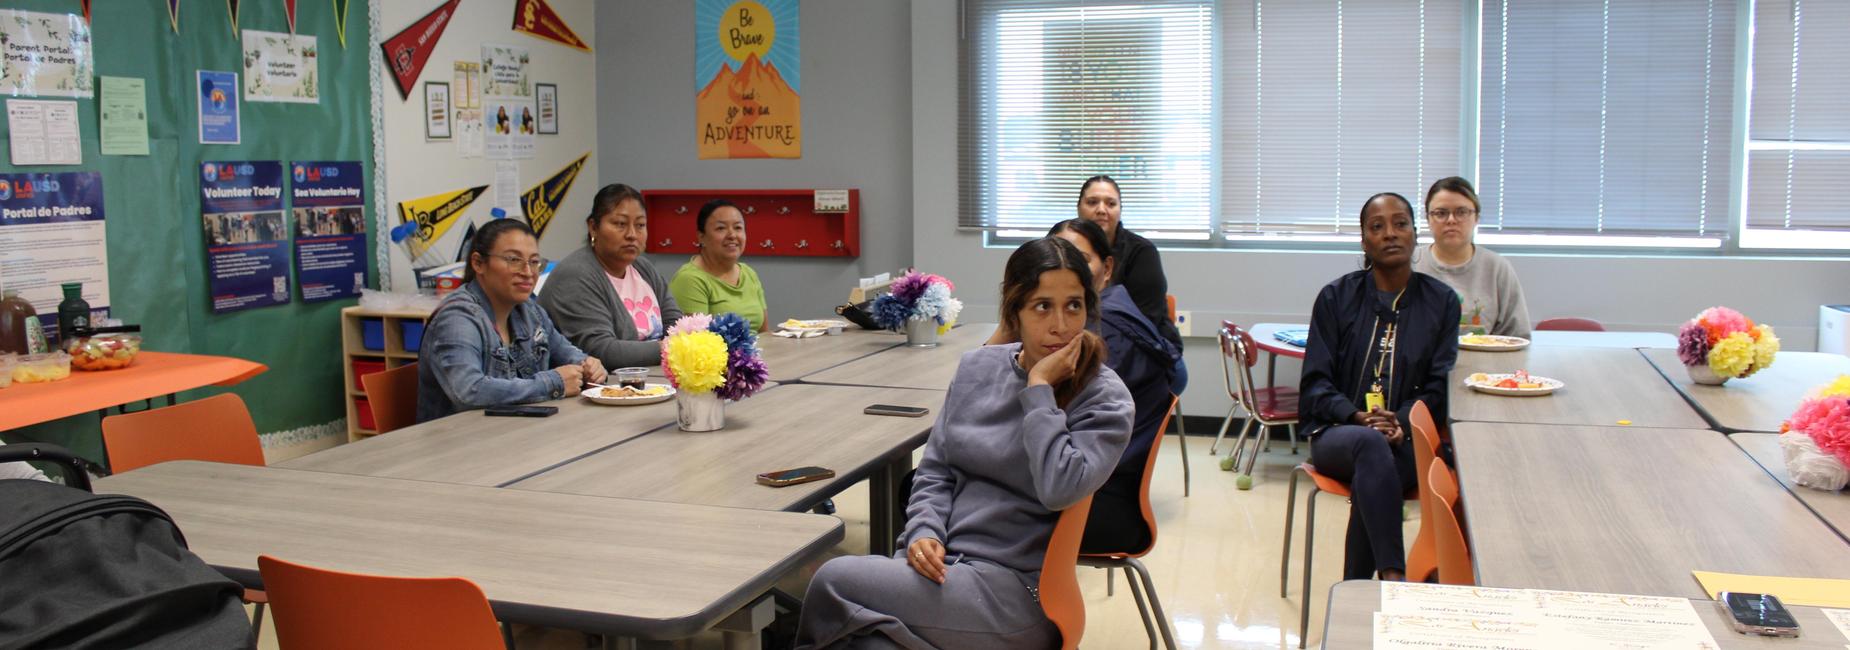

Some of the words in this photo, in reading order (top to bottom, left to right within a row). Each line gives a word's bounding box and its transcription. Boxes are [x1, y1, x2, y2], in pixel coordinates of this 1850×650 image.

[739, 8, 753, 27] Be
[729, 28, 764, 49] Brave
[10, 43, 40, 52] Parent
[48, 55, 76, 64] Padres
[725, 106, 739, 124] go
[742, 105, 756, 116] on
[758, 105, 770, 116] an
[704, 123, 795, 146] ADVENTURE
[217, 164, 255, 178] LAUSD
[306, 167, 339, 178] LAUSD
[15, 180, 60, 193] LAUSD
[204, 186, 252, 198] Volunteer
[252, 185, 281, 199] Today
[309, 186, 347, 197] Voluntario
[527, 183, 548, 224] Cal
[3, 206, 37, 219] Portal
[38, 206, 51, 217] de
[52, 205, 92, 217] Padres
